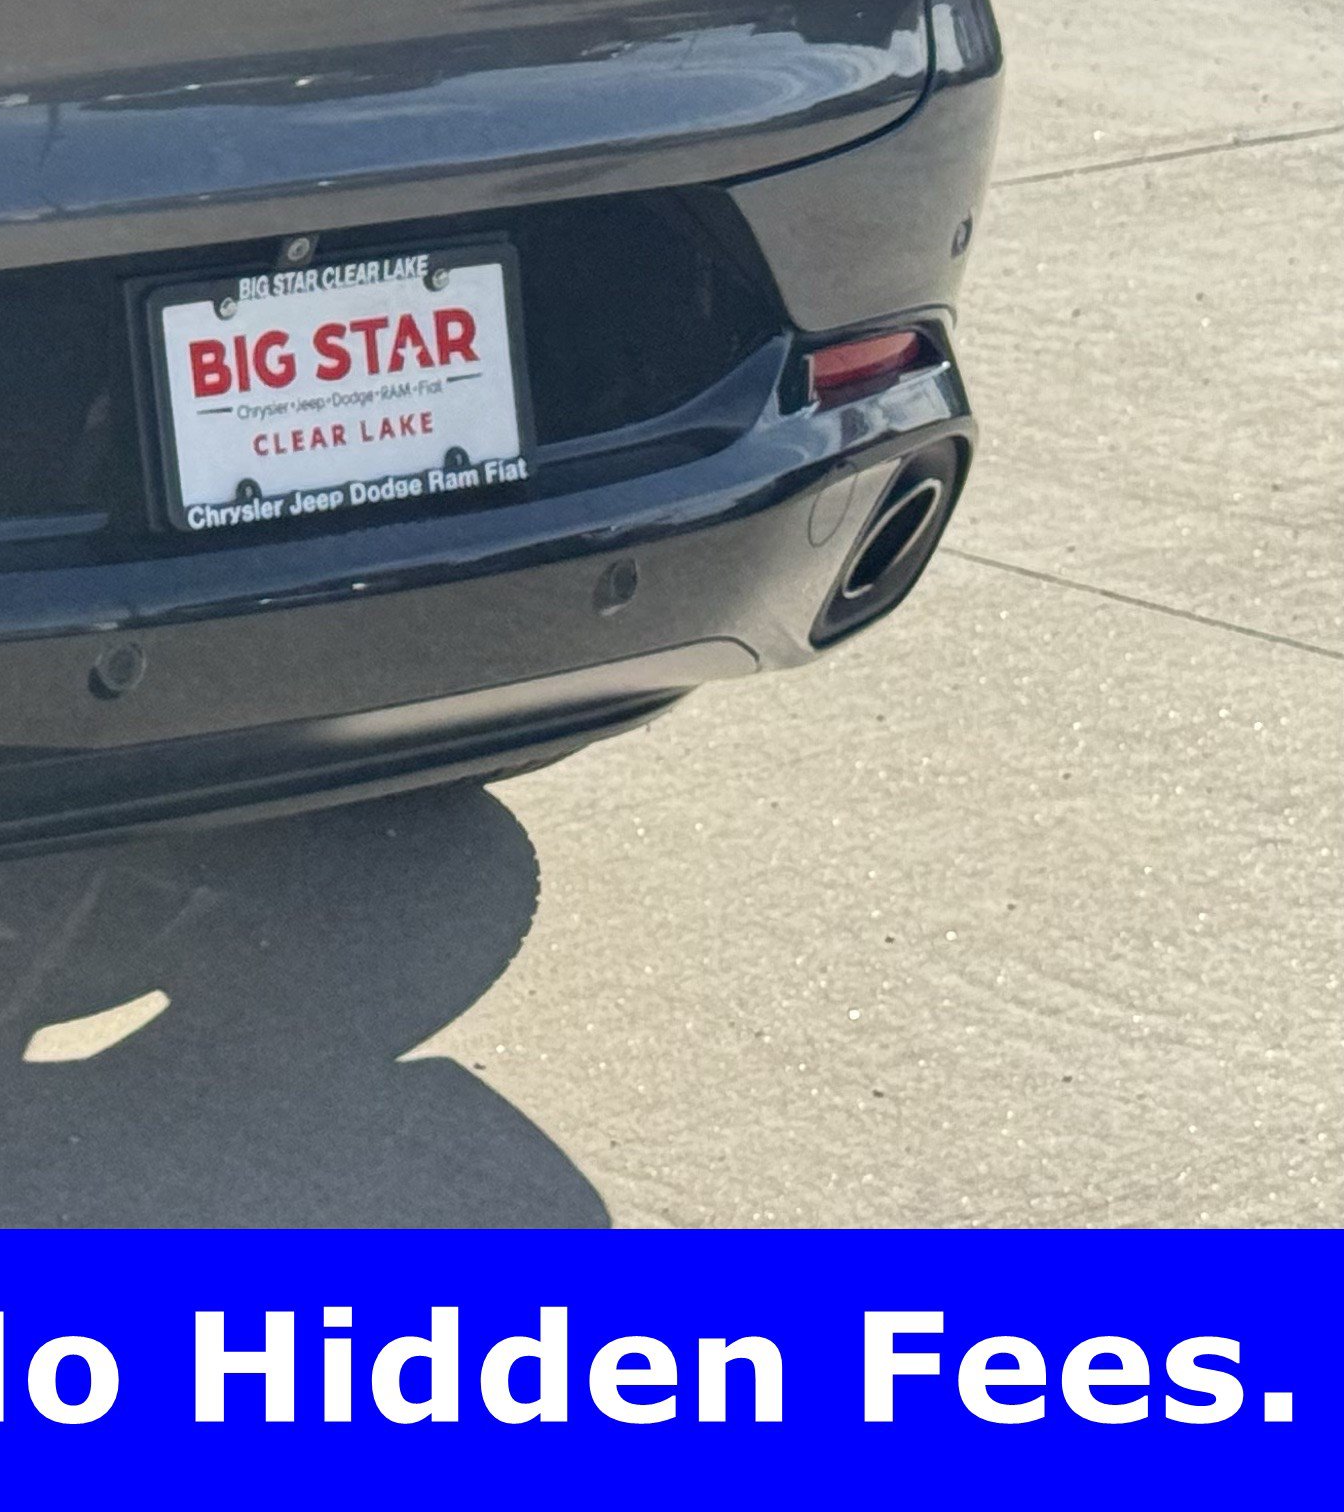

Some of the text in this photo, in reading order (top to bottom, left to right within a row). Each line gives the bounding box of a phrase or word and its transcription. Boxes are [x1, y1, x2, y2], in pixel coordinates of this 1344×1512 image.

[238, 254, 429, 299] BIG STAR CLEAR LAKE
[188, 306, 481, 398] BIG STAR
[252, 411, 434, 456] CLEAR LAKE
[187, 455, 529, 531] Chrysler Jeep Dodge Ram Fiat
